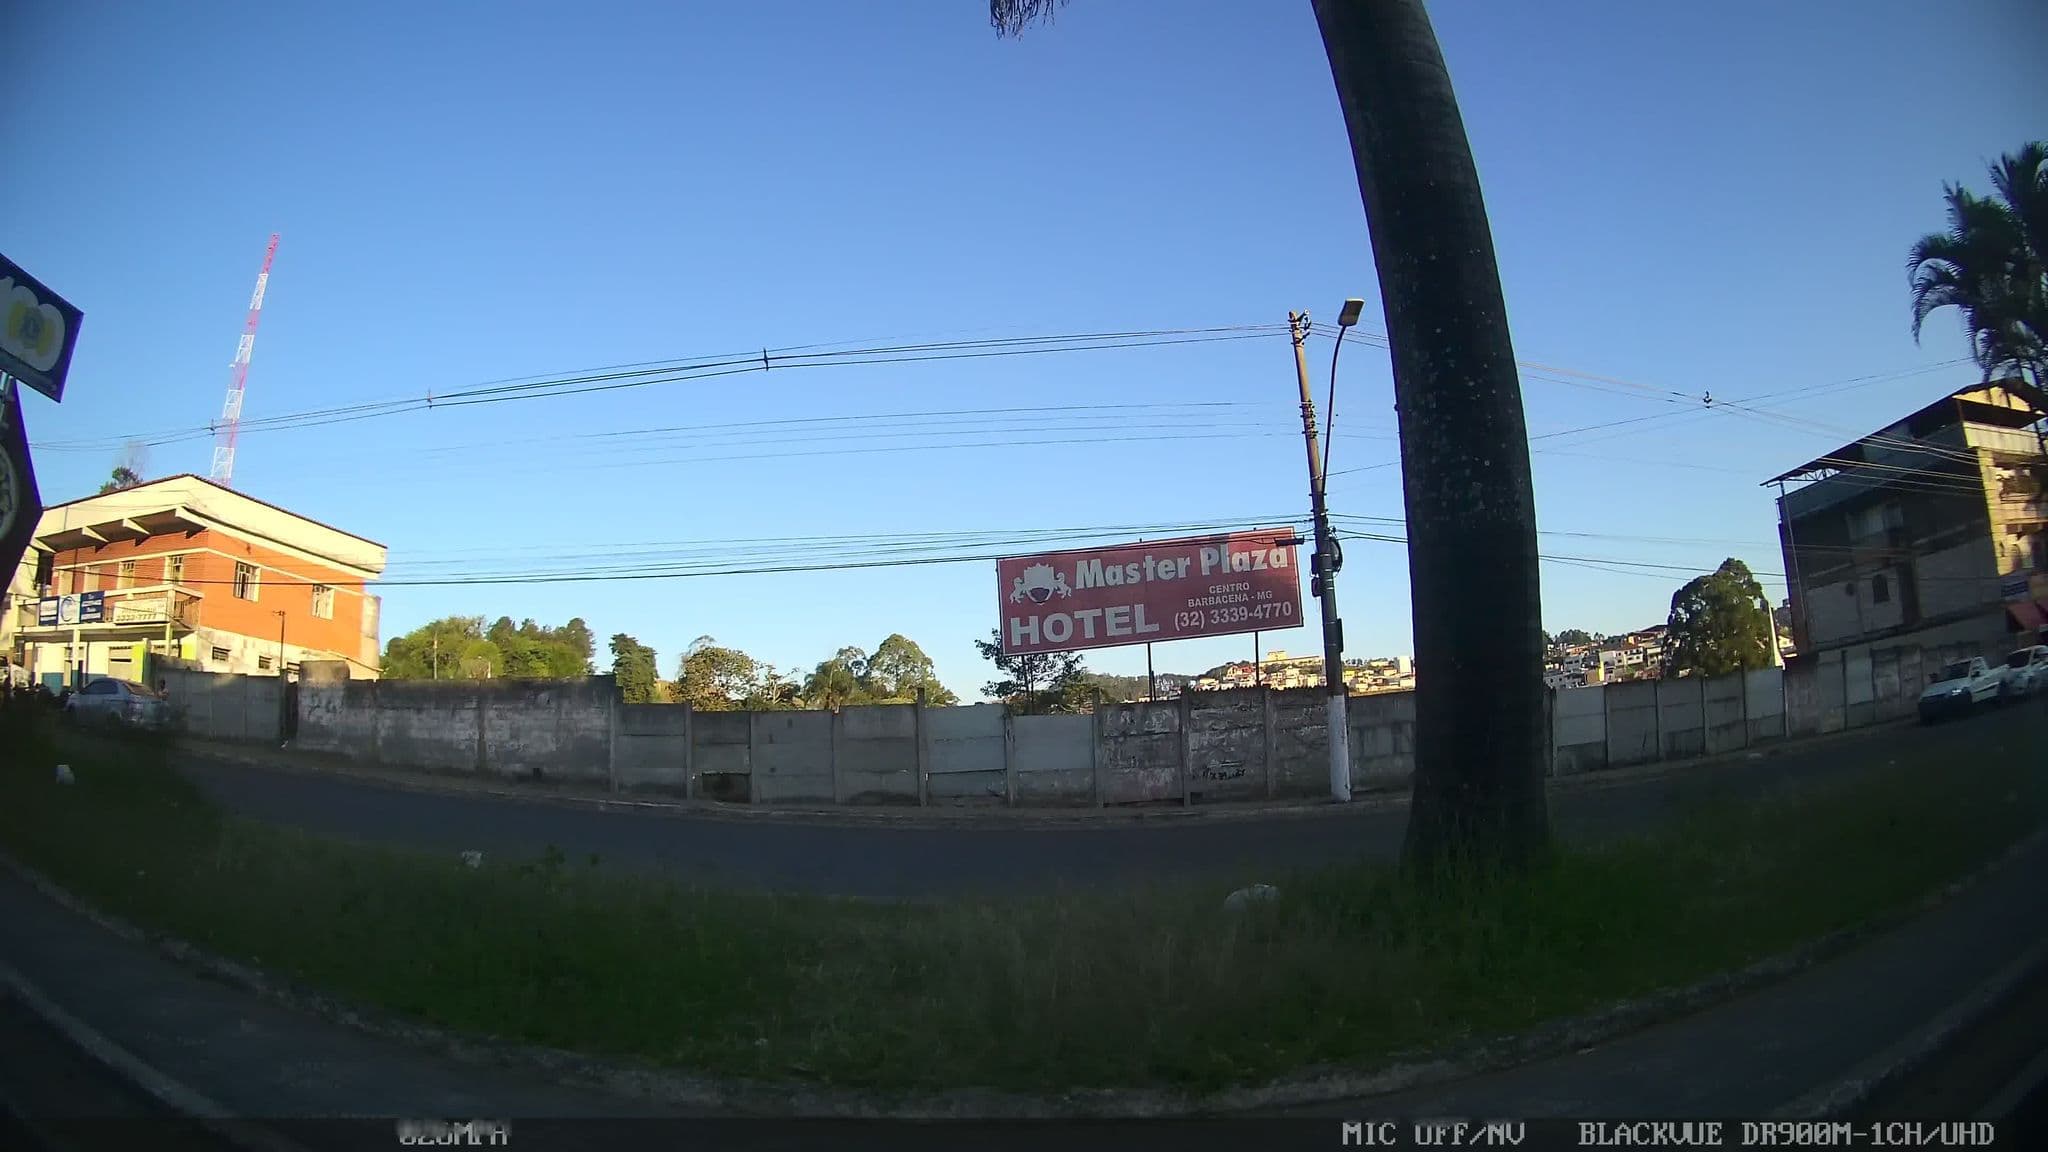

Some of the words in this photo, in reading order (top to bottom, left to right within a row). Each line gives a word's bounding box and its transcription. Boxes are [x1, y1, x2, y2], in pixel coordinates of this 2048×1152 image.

[1075, 556, 1190, 589] Master
[1200, 544, 1288, 576] Plaza
[1188, 594, 1249, 608] BARBACENA
[1257, 590, 1273, 600] MG
[1209, 582, 1250, 594] CENTRO
[1010, 604, 1159, 646] HOTEL
[1174, 610, 1205, 632] (32)
[1211, 601, 1292, 625] 3339-4770
